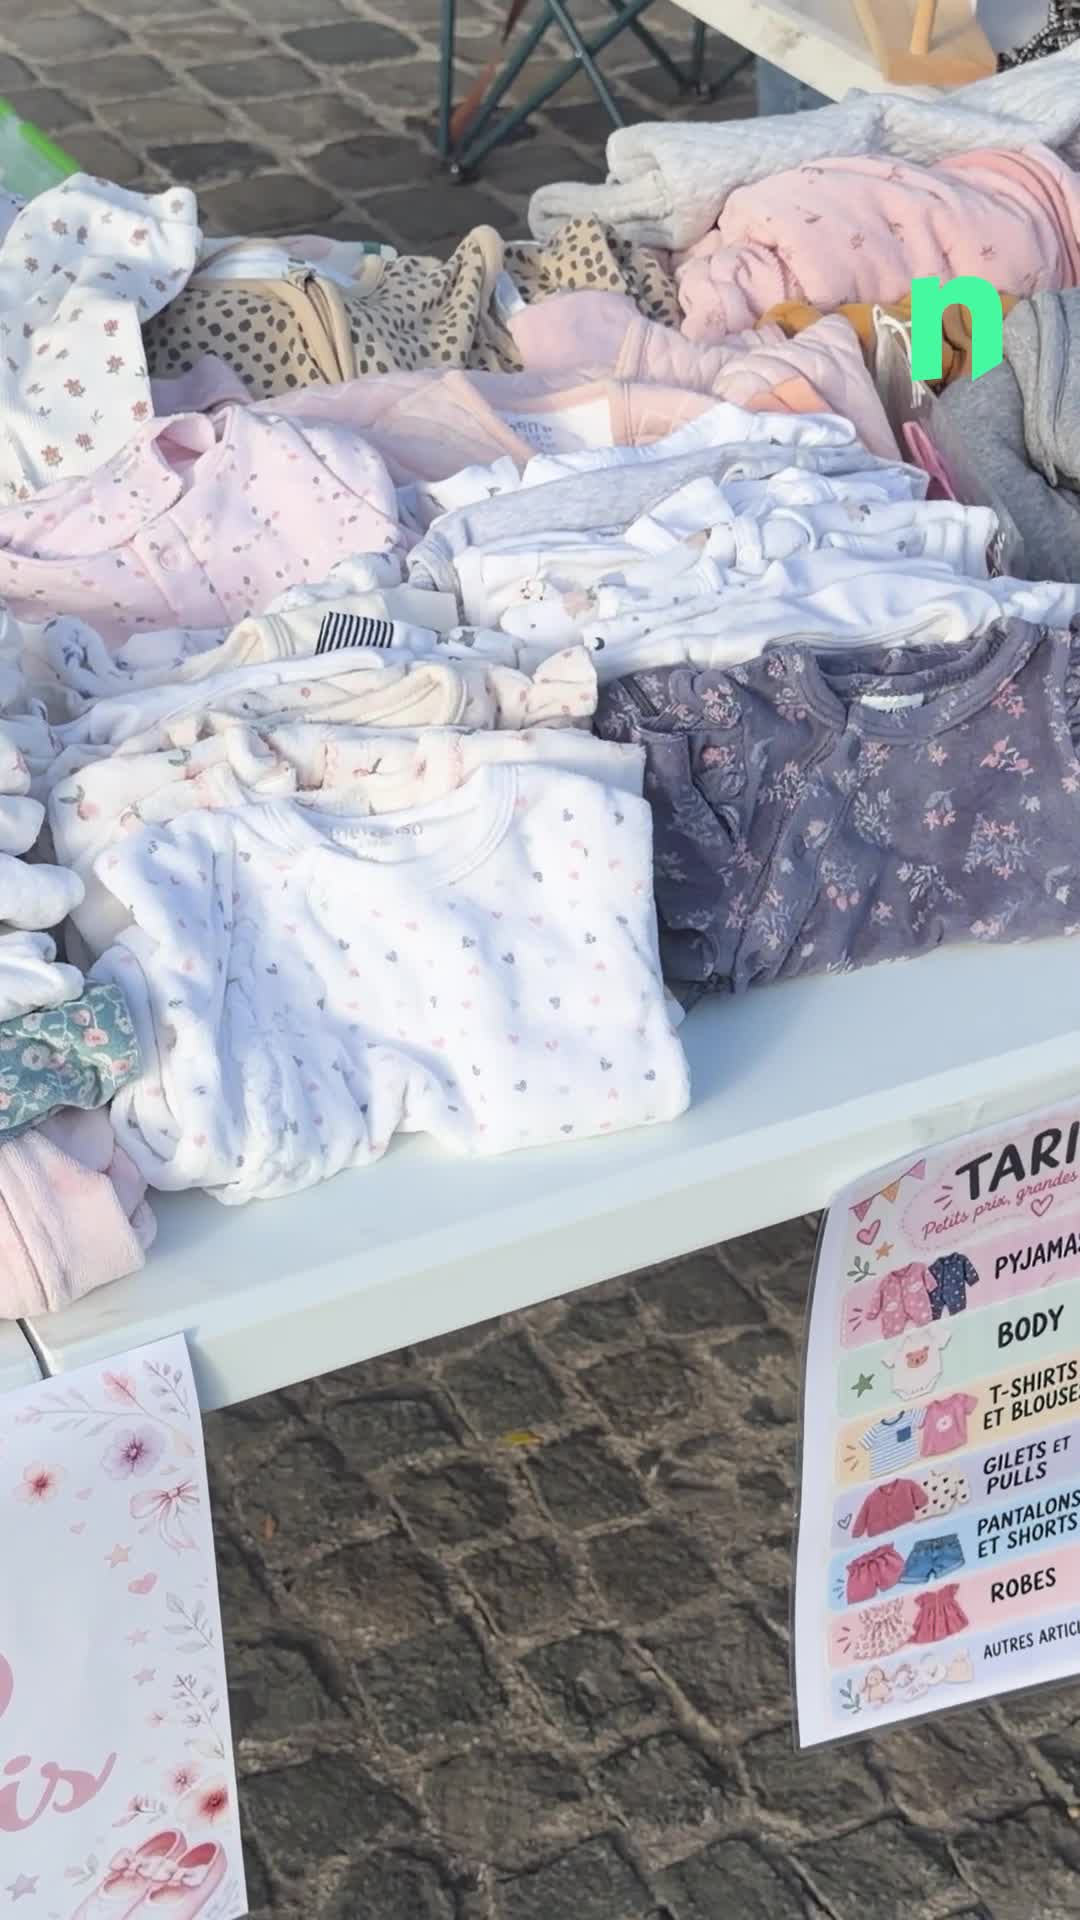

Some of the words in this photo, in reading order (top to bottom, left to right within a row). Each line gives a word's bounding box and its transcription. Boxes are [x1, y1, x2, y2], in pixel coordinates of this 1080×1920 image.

[955, 1121, 1080, 1200] TARI
[922, 1209, 969, 1240] Petits
[972, 1194, 1011, 1223] prix,
[1026, 1170, 1079, 1206] grandes
[995, 1232, 1080, 1279] PYJAMA
[998, 1304, 1064, 1348] BODY
[989, 1360, 1077, 1404] T-SHIRTS
[983, 1407, 1005, 1430] ET
[1011, 1383, 1080, 1421] BLOUSE
[983, 1440, 1047, 1475] GILETS
[1053, 1435, 1072, 1452] ET
[986, 1461, 1048, 1495] PULLS
[977, 1489, 1080, 1537] PANTALONS
[978, 1535, 1001, 1558] ET
[1007, 1512, 1077, 1549] SHORTS
[990, 1567, 1057, 1603] ROBES
[983, 1632, 1034, 1660] AUTRES
